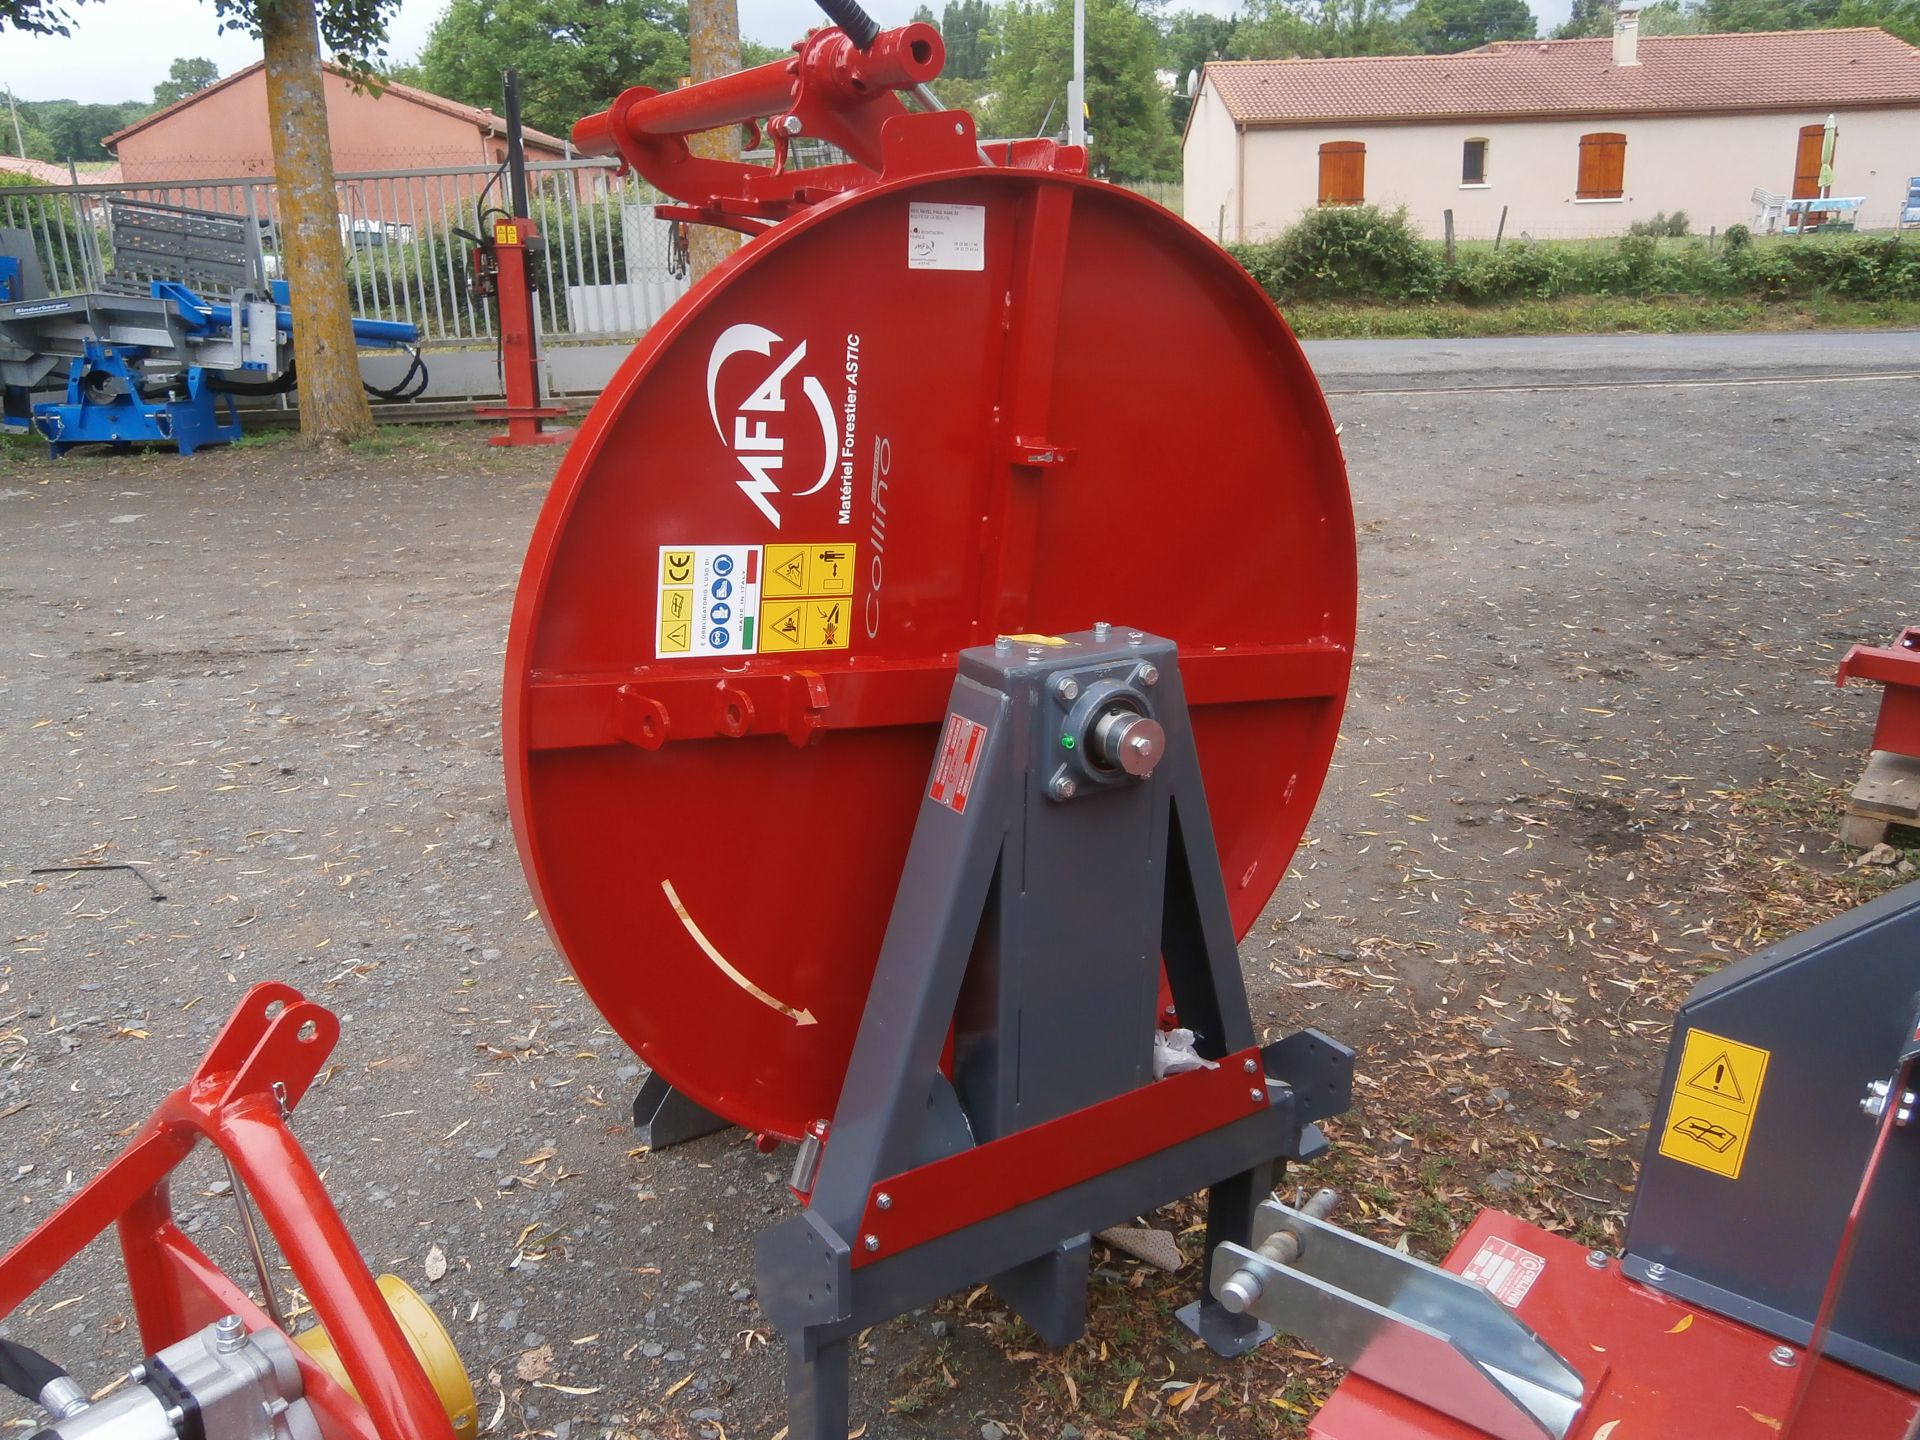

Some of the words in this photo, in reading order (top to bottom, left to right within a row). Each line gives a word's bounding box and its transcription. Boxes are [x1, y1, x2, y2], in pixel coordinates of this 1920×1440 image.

[845, 333, 860, 386] ASTIC
[734, 339, 807, 530] MFA
[841, 388, 857, 457] Forestier
[838, 461, 854, 525] Matériel
[866, 438, 891, 639] Collino
[669, 555, 690, 581] CE
[701, 589, 709, 640] OBBLIGATORIO
[740, 595, 745, 605] IN
